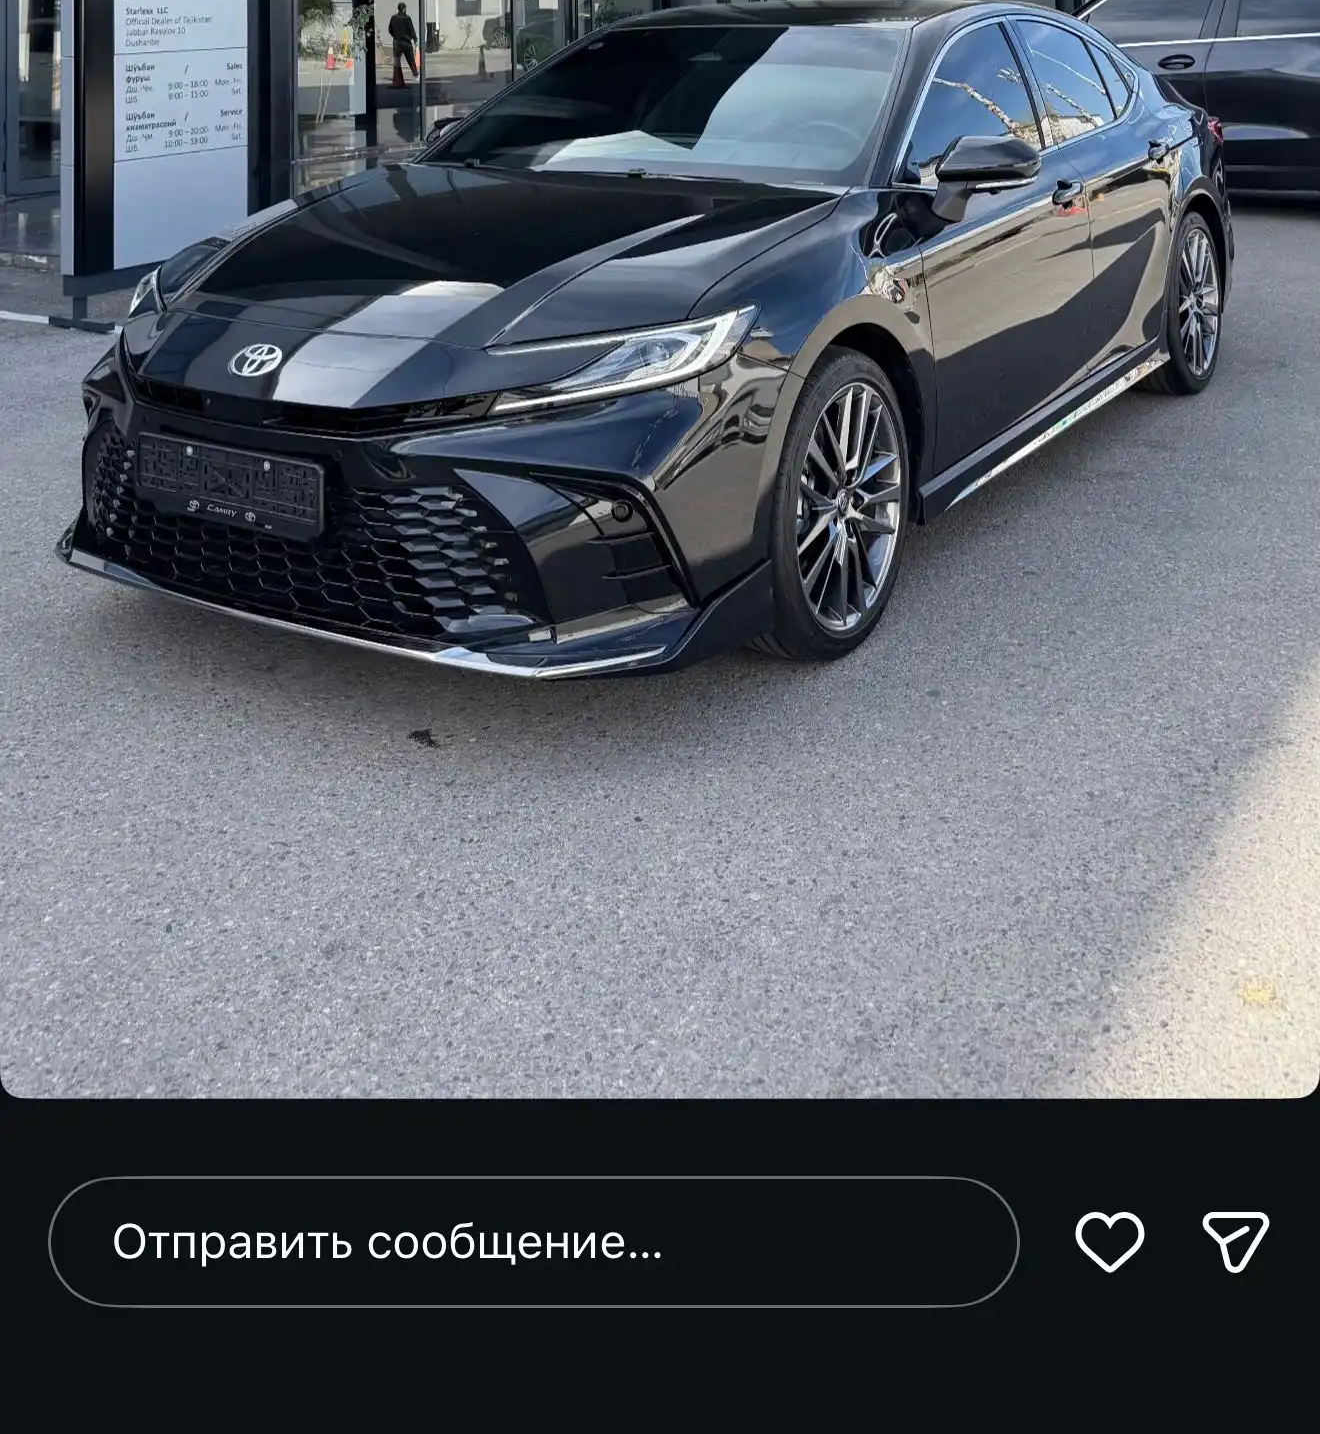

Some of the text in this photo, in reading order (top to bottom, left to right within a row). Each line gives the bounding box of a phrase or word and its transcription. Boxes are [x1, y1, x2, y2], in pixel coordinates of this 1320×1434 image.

[126, 7, 153, 15] Starlexx
[126, 17, 149, 26] Official
[174, 16, 181, 24] of
[183, 16, 212, 25] Tajikistan
[126, 28, 148, 37] Jabbar
[150, 27, 175, 36] Rasulov
[125, 39, 160, 47] Dushanbe
[220, 109, 243, 117] Service
[207, 504, 237, 517] CAMRY
